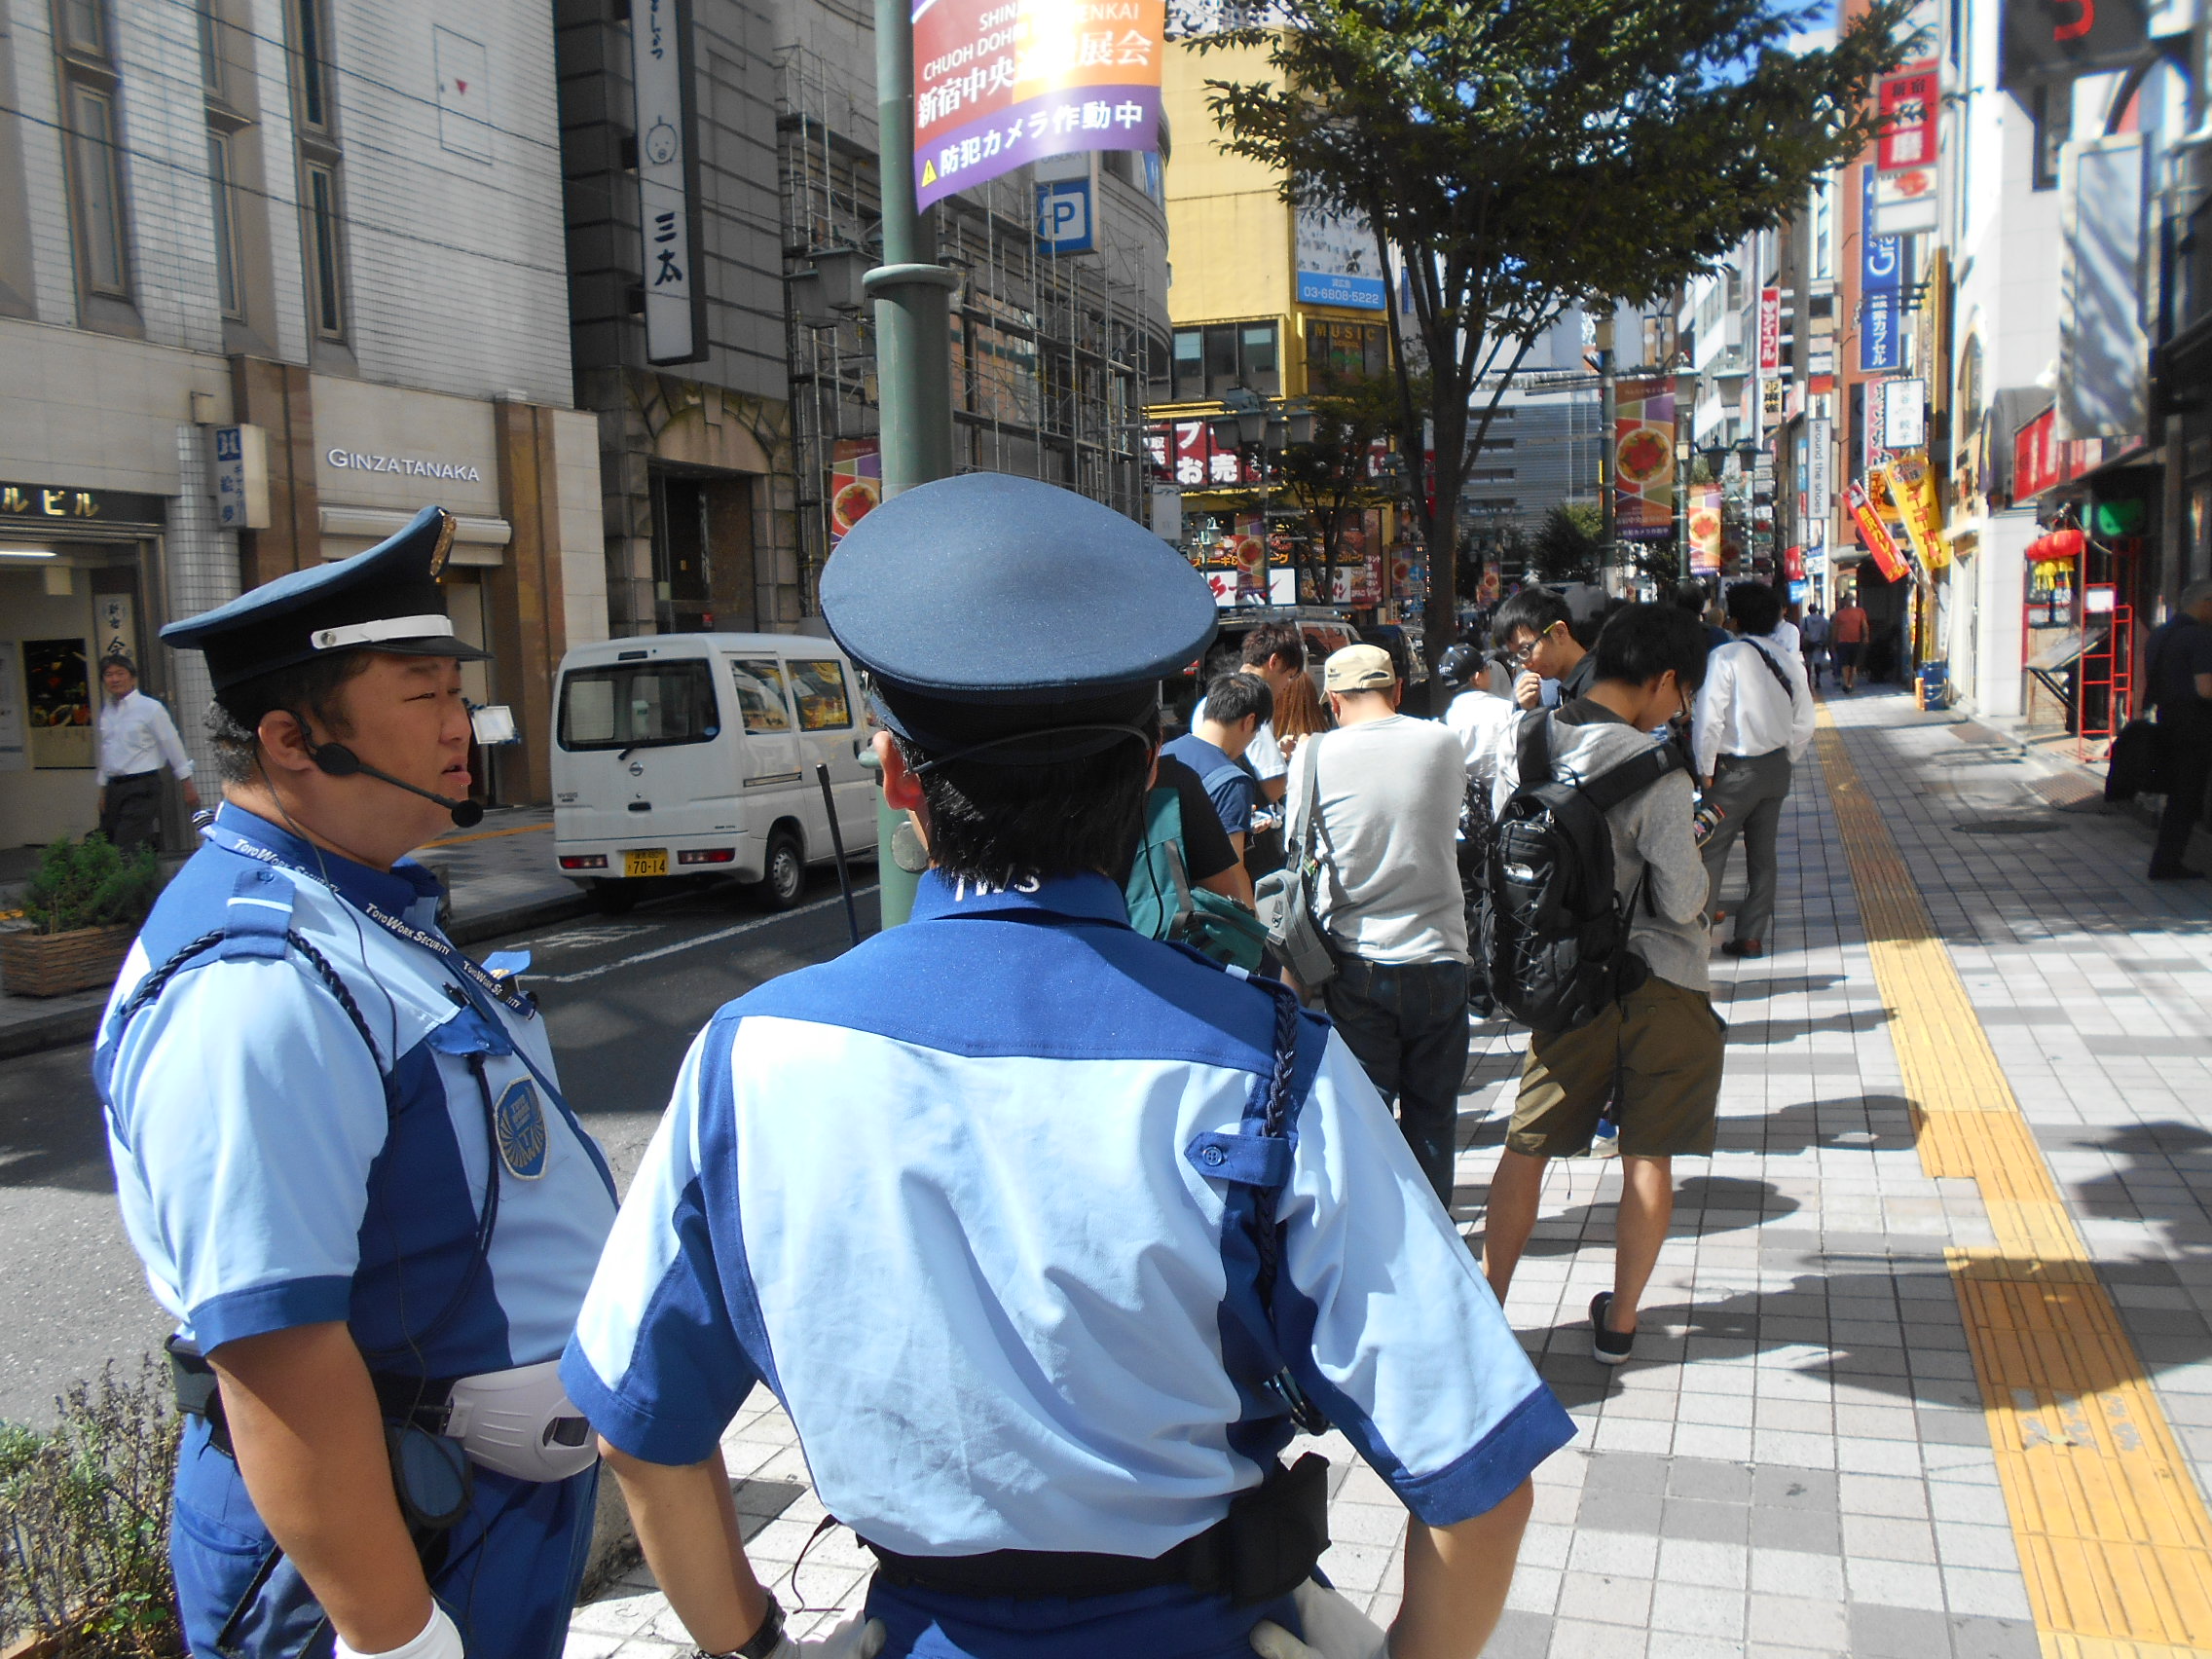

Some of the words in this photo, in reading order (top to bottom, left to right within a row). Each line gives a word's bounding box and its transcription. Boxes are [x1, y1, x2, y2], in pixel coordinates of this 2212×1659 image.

[923, 42, 975, 82] CHUOH
[939, 99, 1144, 178] 防犯カメラ作動中
[1053, 201, 1076, 235] P
[654, 212, 683, 286] 三太
[1314, 322, 1376, 342] MUSIC
[1762, 313, 1778, 361] アイフル
[1814, 461, 1825, 481] the
[1814, 482, 1825, 514] shoes
[413, 930, 451, 956] SECURITY
